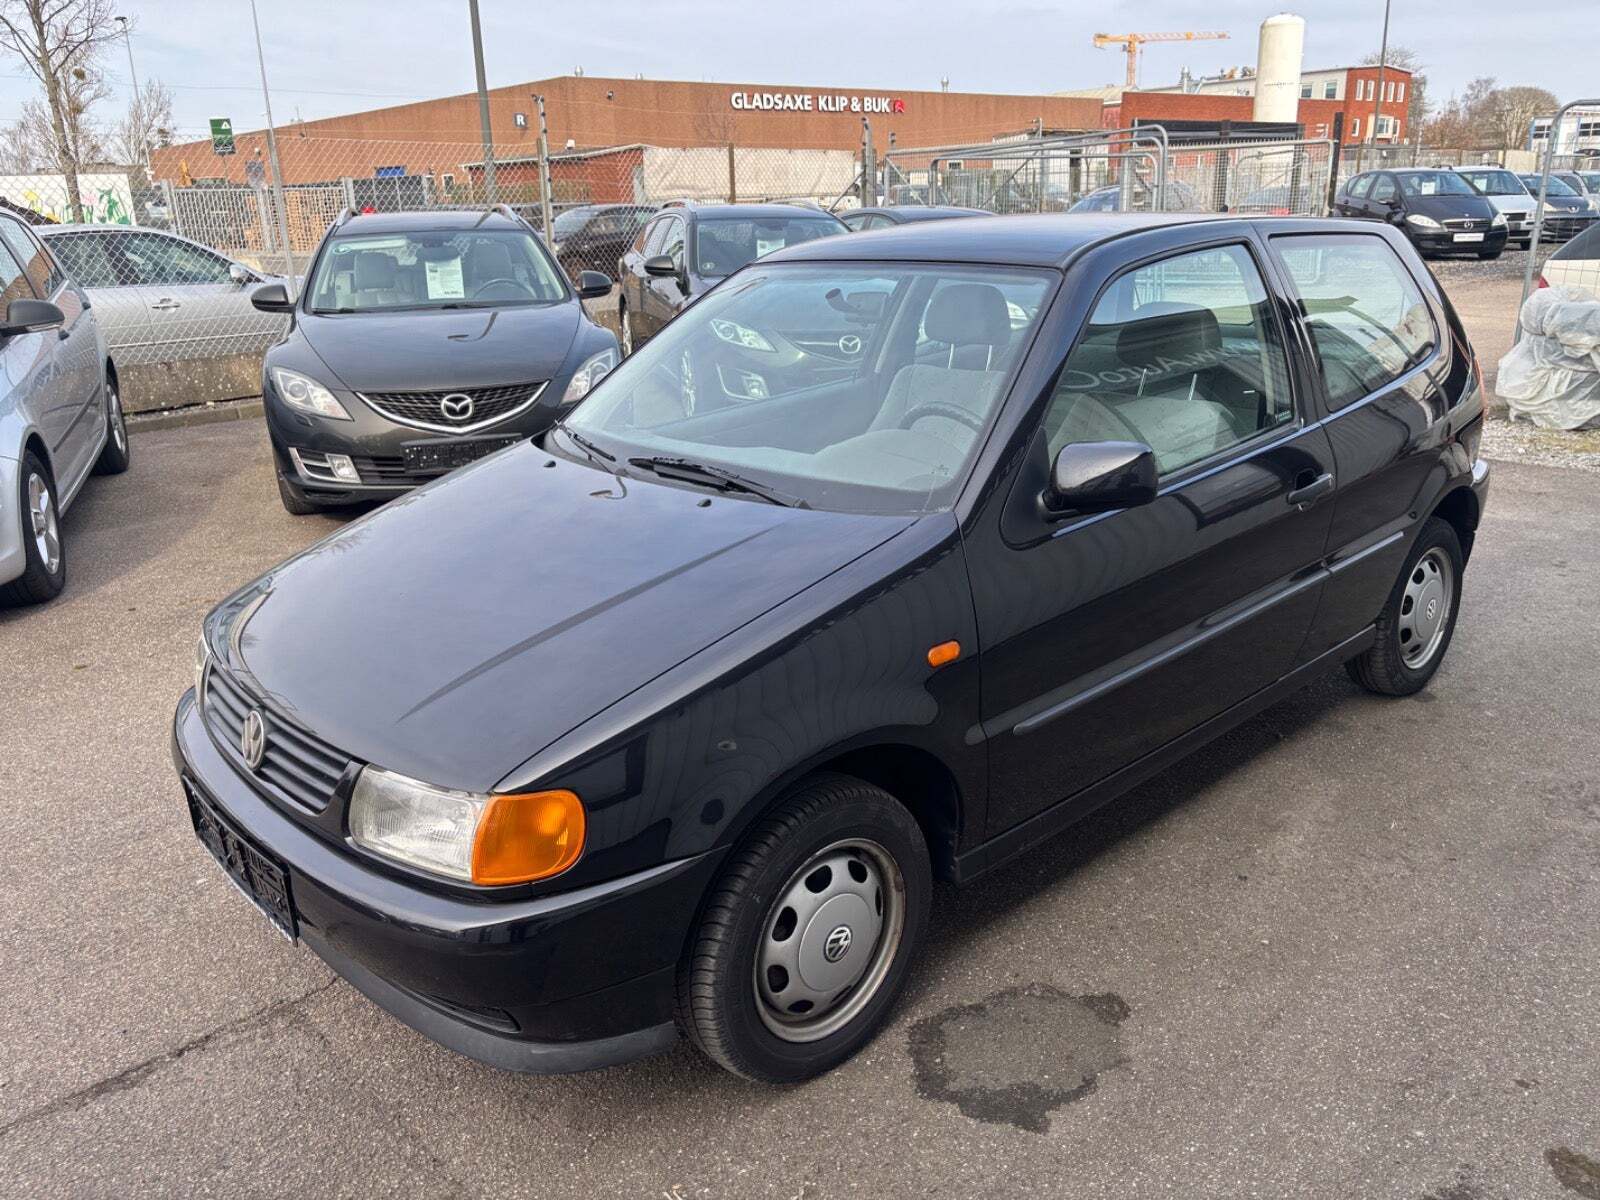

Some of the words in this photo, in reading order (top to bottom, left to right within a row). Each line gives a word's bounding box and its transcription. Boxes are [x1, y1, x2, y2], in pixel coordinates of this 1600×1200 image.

[731, 92, 812, 111] GLADSAXE
[818, 95, 848, 112] KLIP
[850, 96, 861, 112] &
[863, 97, 890, 113] BUK
[516, 114, 526, 126] R
